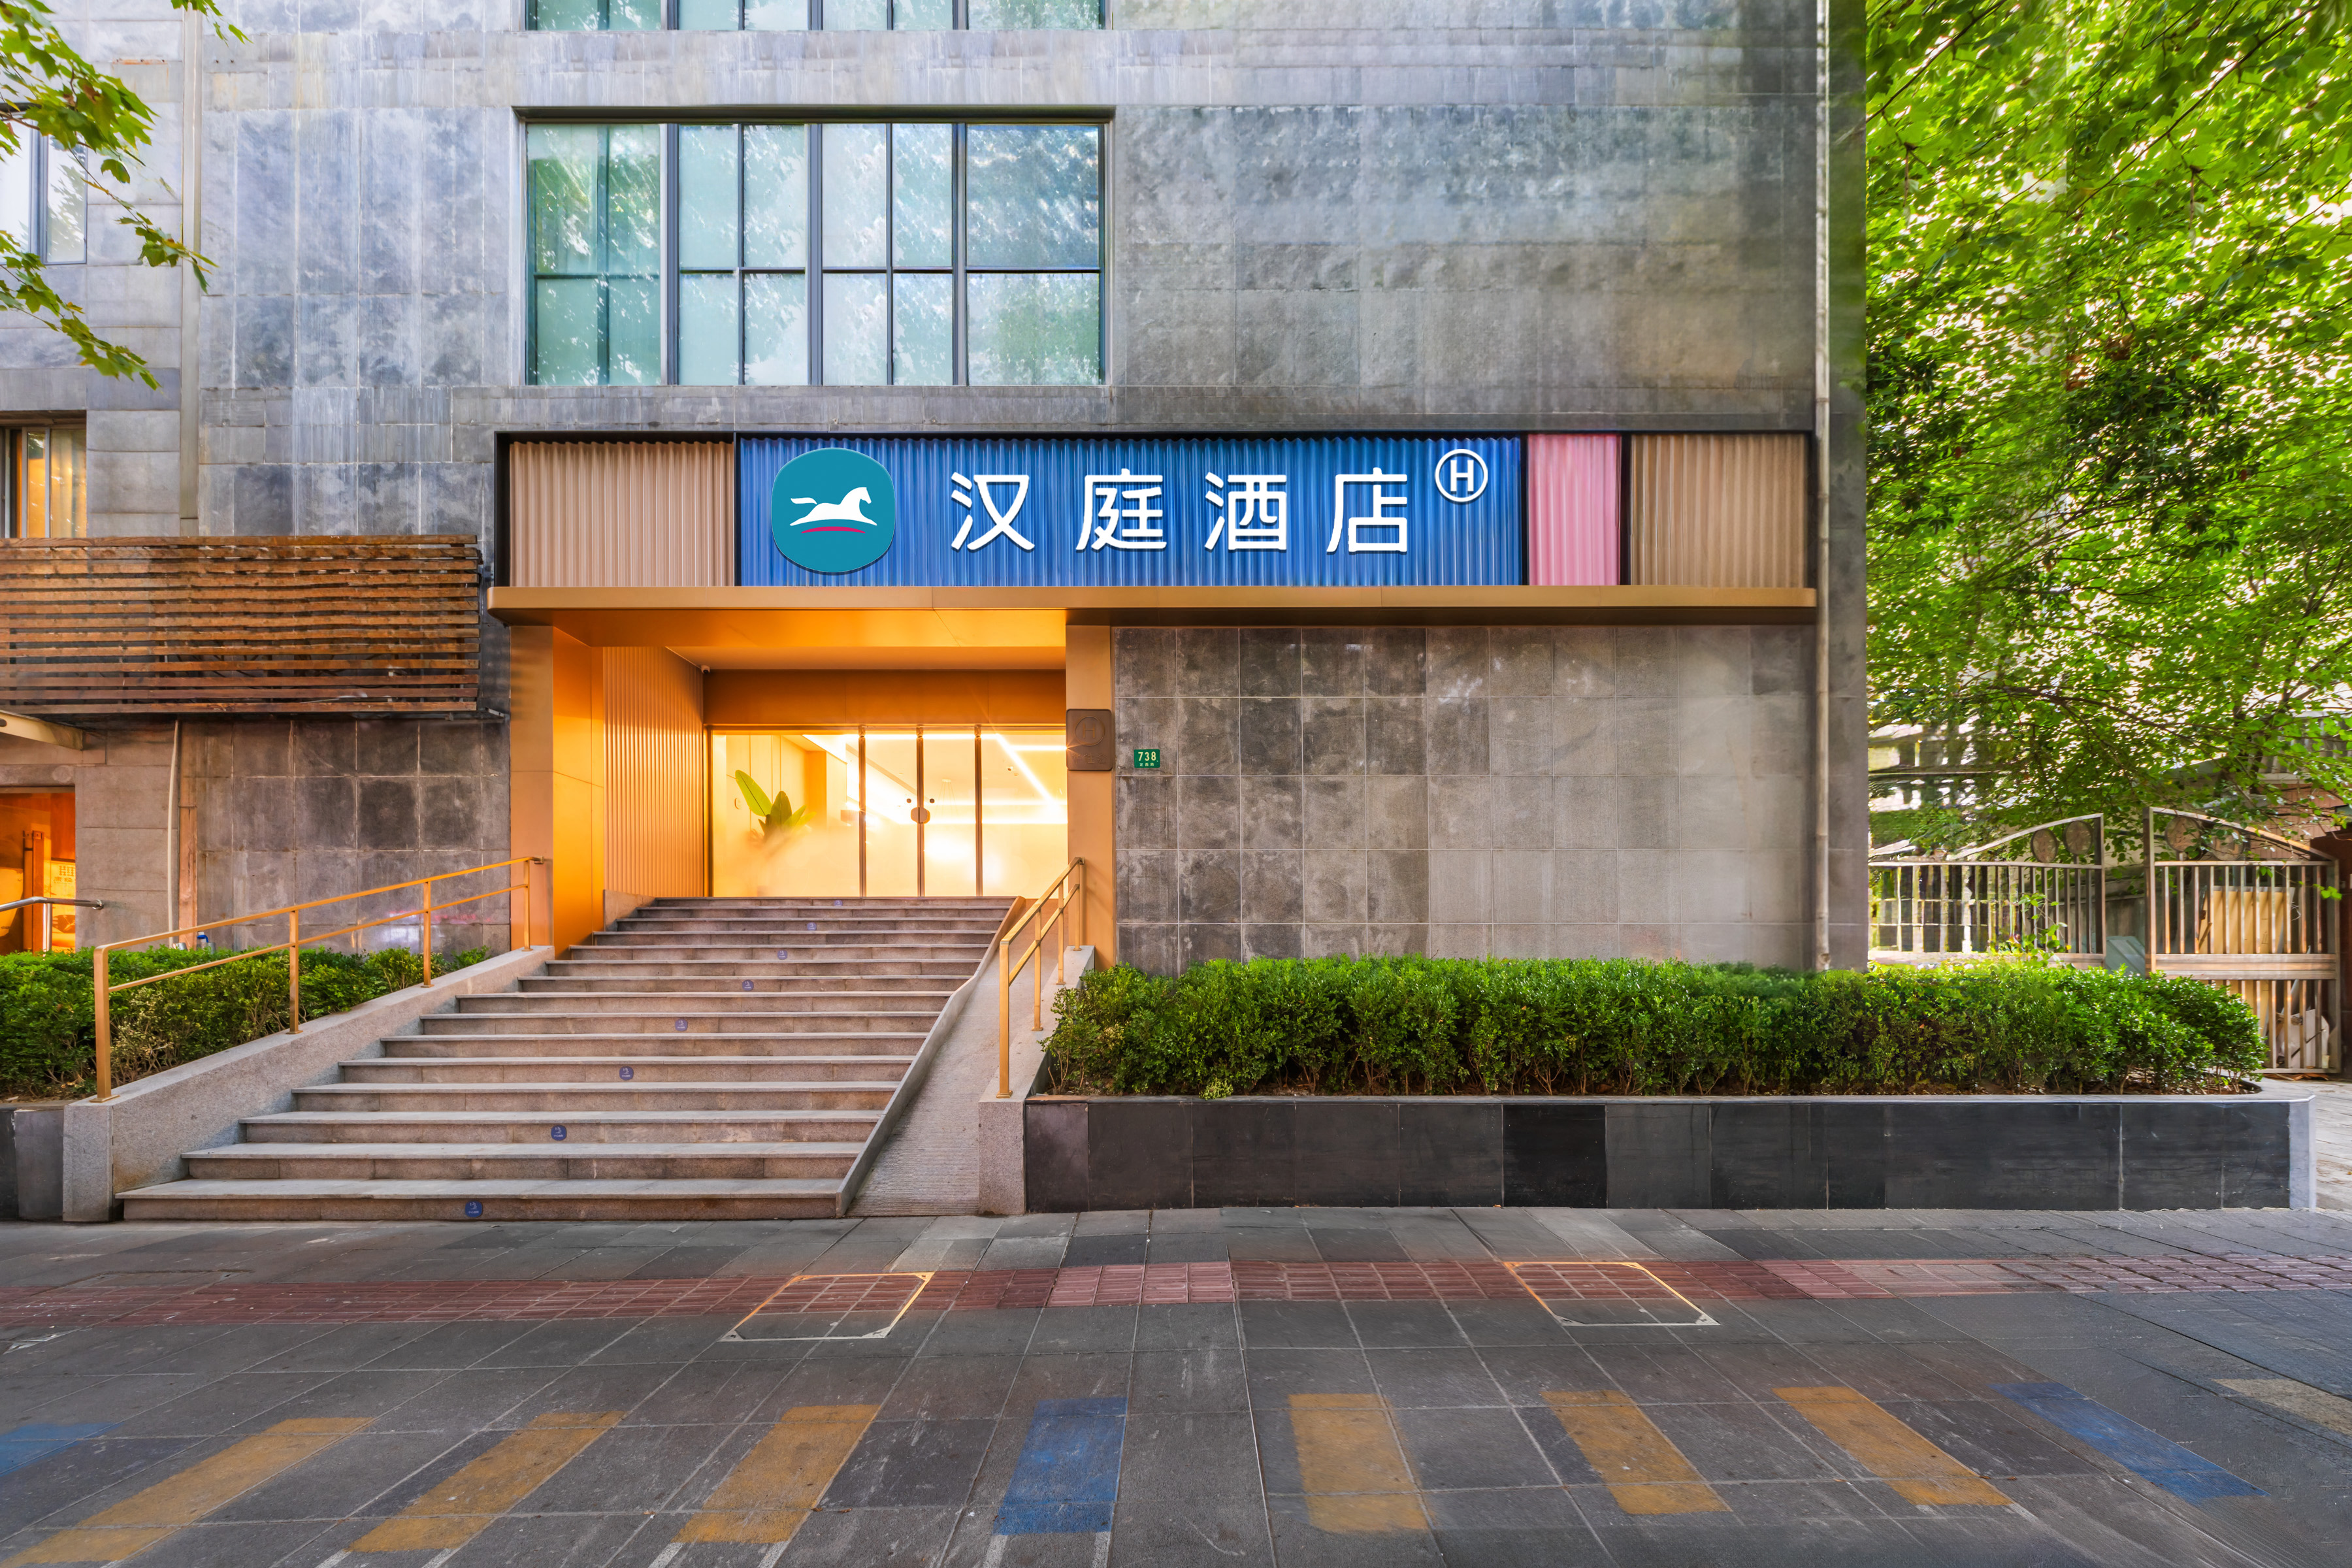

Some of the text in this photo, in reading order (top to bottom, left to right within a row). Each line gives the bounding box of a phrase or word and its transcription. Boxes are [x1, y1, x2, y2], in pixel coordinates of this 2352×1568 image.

[1450, 459, 1475, 493] H
[951, 467, 1408, 553] 汉庭酒店
[1071, 753, 1108, 764] 华住会
[1138, 751, 1156, 762] 738
